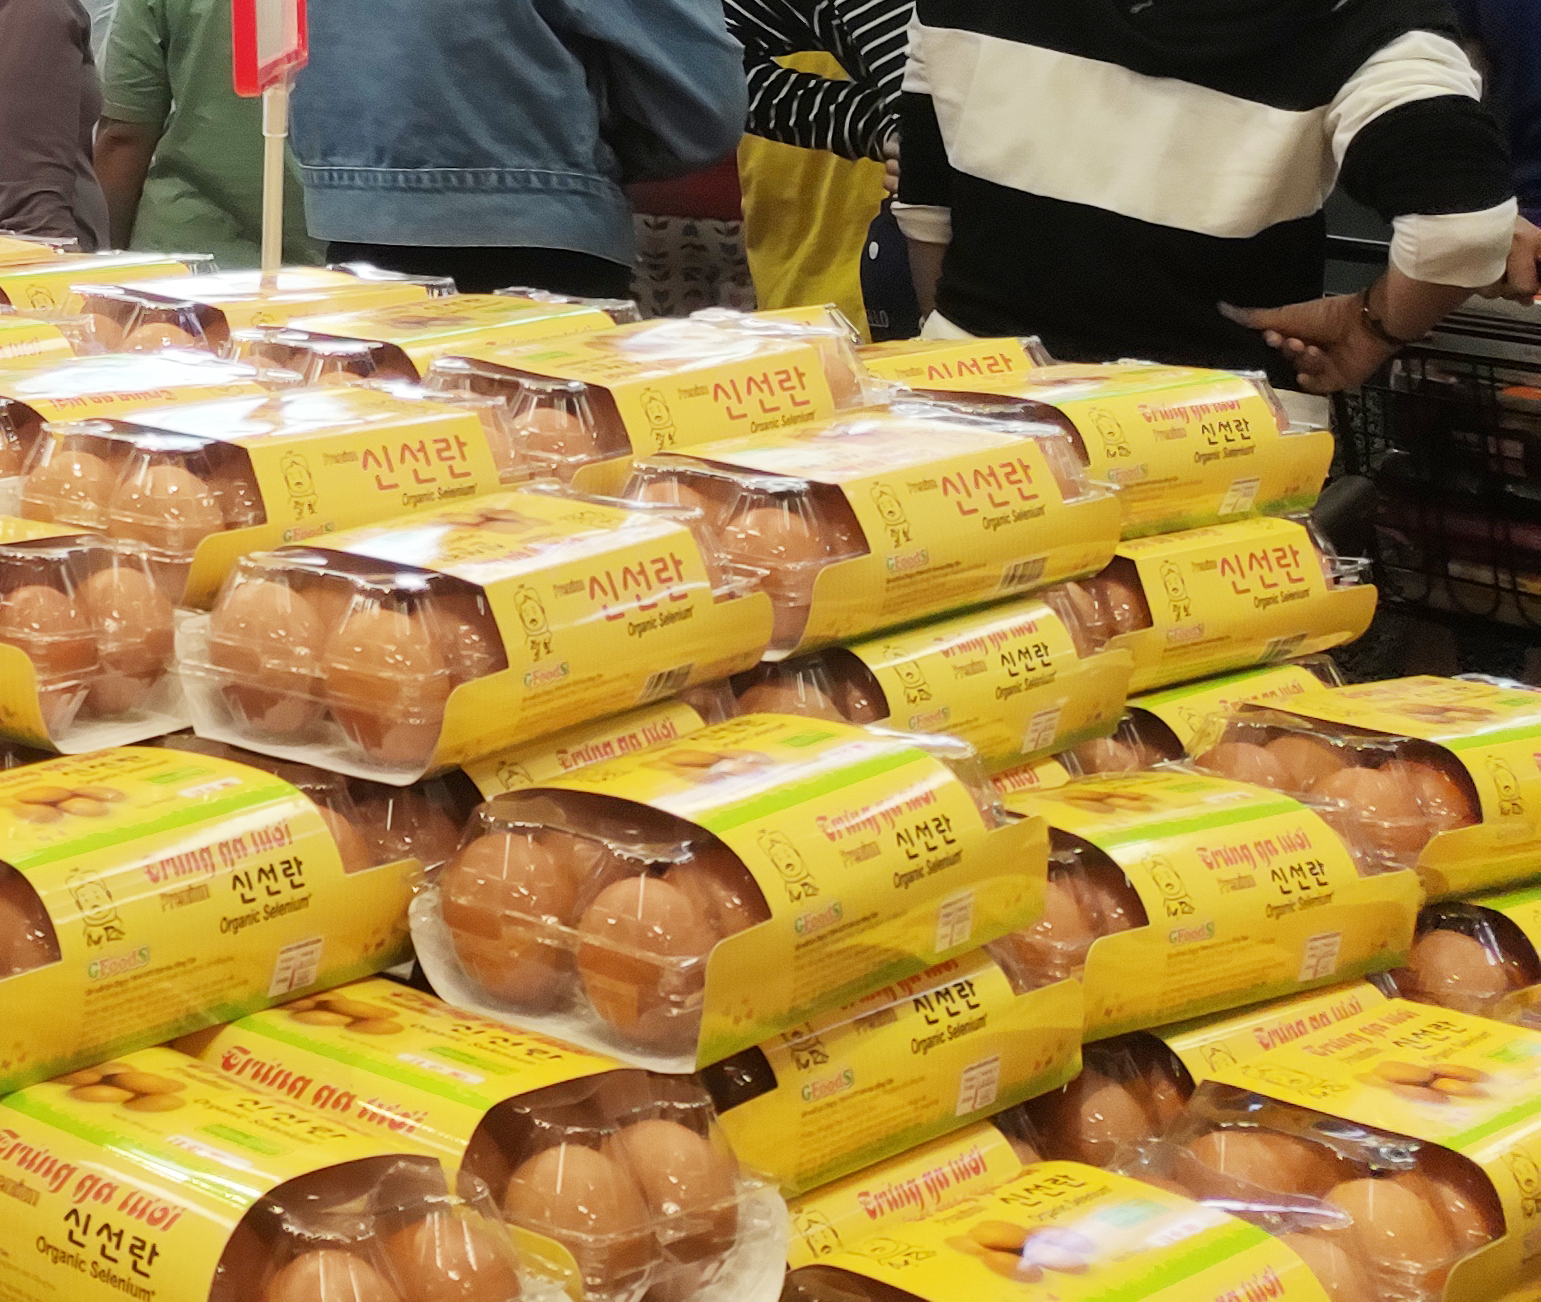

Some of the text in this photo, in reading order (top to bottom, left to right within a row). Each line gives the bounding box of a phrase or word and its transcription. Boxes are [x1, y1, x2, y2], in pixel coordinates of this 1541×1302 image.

[712, 365, 811, 420] 신선란
[361, 435, 472, 490] 신선란
[941, 457, 1039, 516] 신선란
[588, 552, 689, 621] 신선란
[1220, 544, 1305, 595] 신선란
[896, 814, 956, 860] 신선란
[231, 856, 306, 903] 신선란
[1270, 858, 1329, 895] 신선란
[912, 979, 981, 1026] 신선란
[36, 1235, 88, 1274] Organic
[63, 1207, 160, 1279] 신선란
